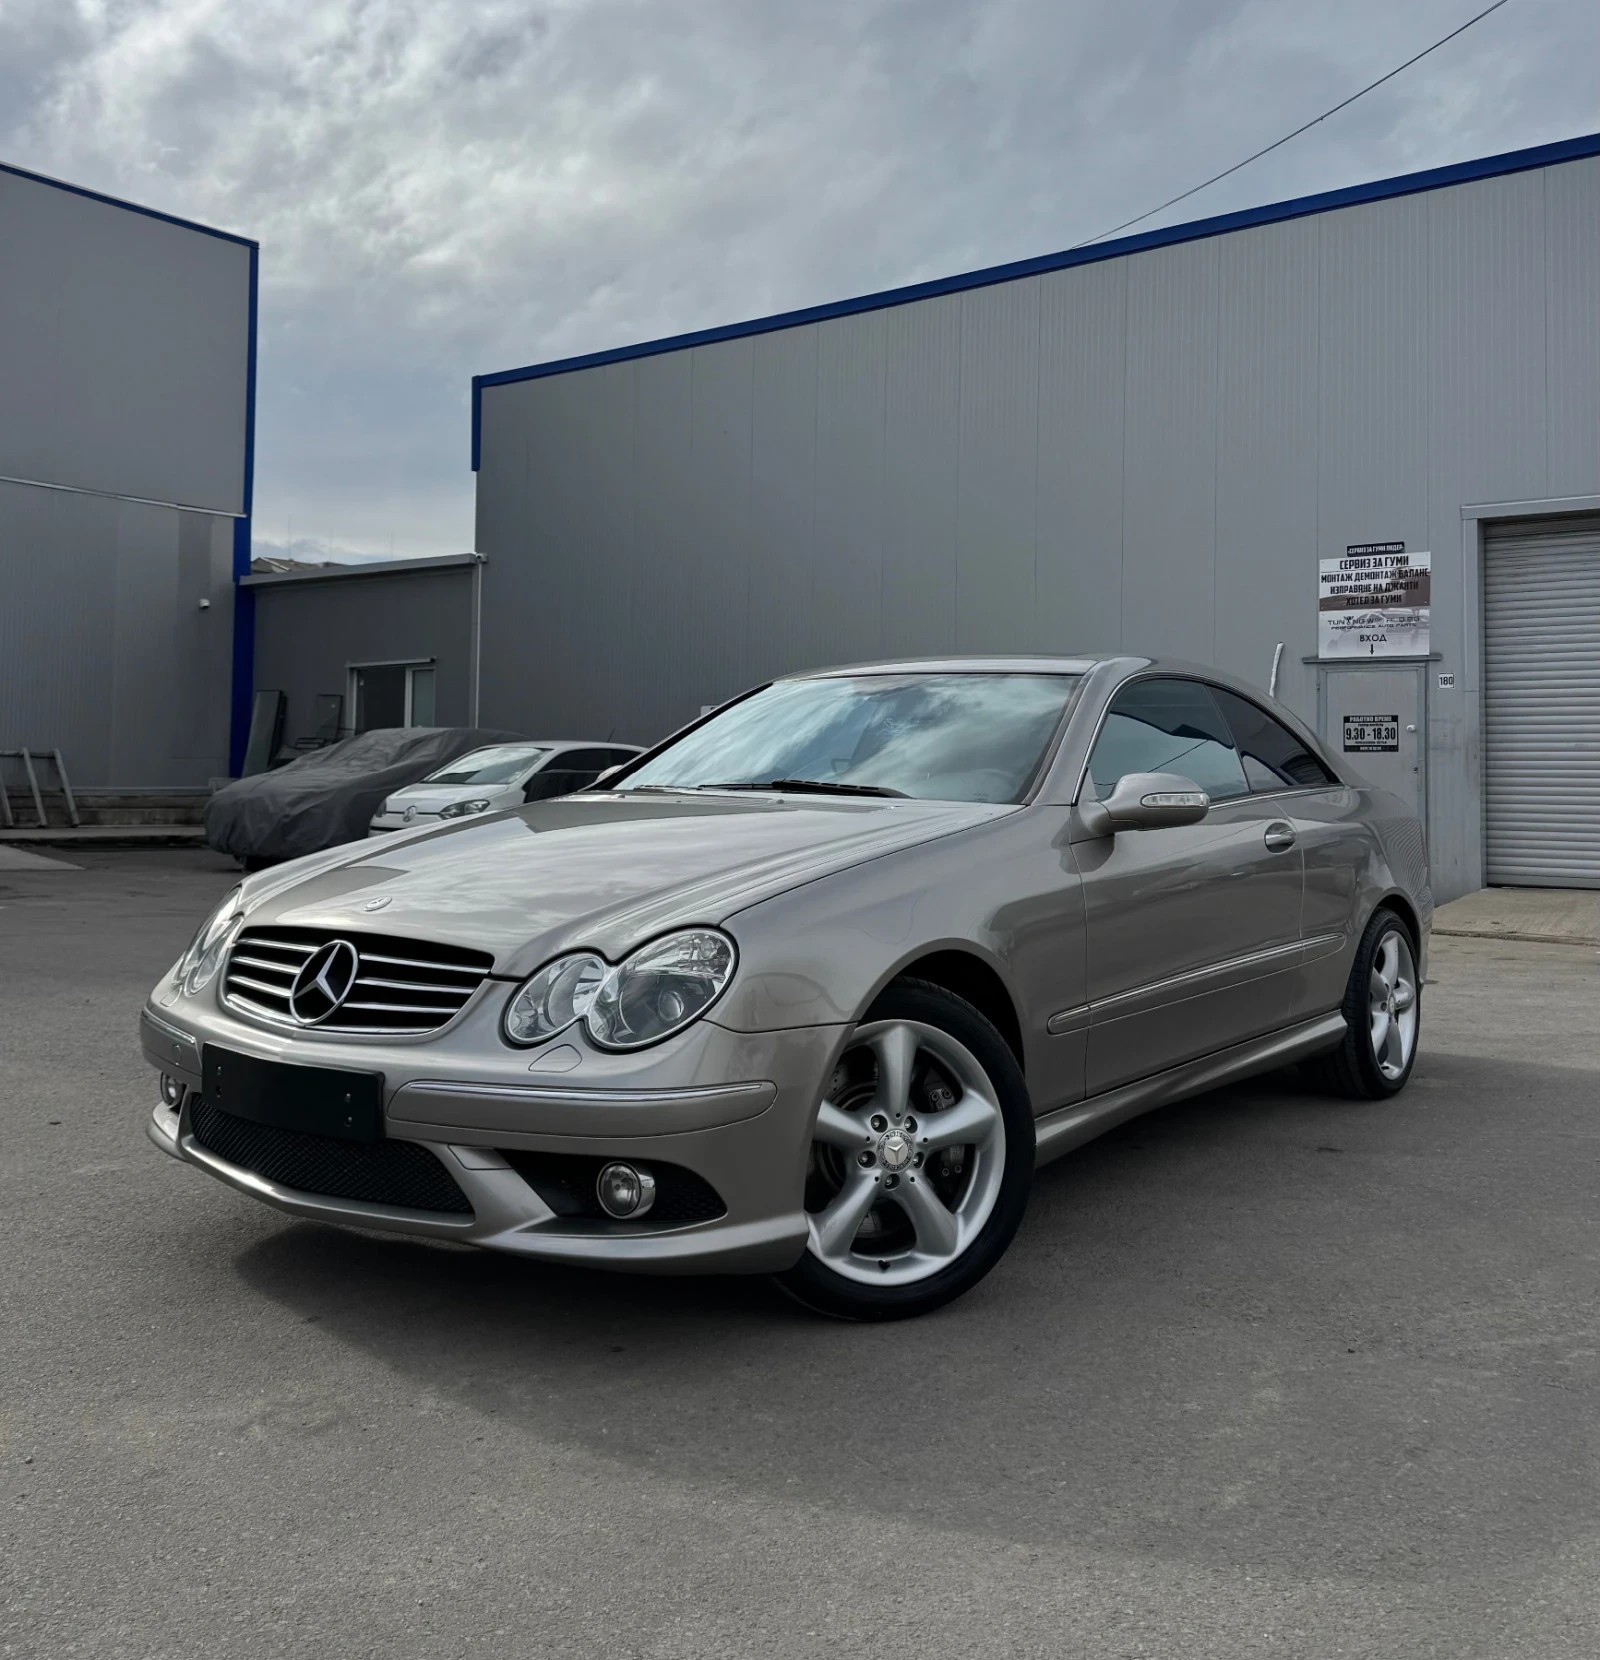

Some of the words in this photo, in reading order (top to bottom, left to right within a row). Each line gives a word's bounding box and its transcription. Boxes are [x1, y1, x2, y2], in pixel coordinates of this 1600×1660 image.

[1340, 558, 1370, 570] СЕРВИЗ
[1372, 557, 1383, 568] ЗА
[1385, 555, 1409, 567] ГУМИ
[1321, 572, 1353, 583] МОНТАЖ
[1354, 570, 1397, 582] ДЕМОНТАЖ
[1330, 583, 1371, 594] ИЗПРАВЯНЕ
[1373, 583, 1383, 593] НА
[1384, 580, 1418, 592] ДЖАНТИ
[1346, 597, 1369, 606] ХОТЕЛ
[1370, 596, 1379, 604] ЗА
[1381, 594, 1402, 604] ГУМИ
[1360, 634, 1387, 642] ВХОД
[1439, 676, 1453, 686] 180
[1346, 727, 1365, 740] 9.30
[1372, 727, 1396, 740] 18.30
